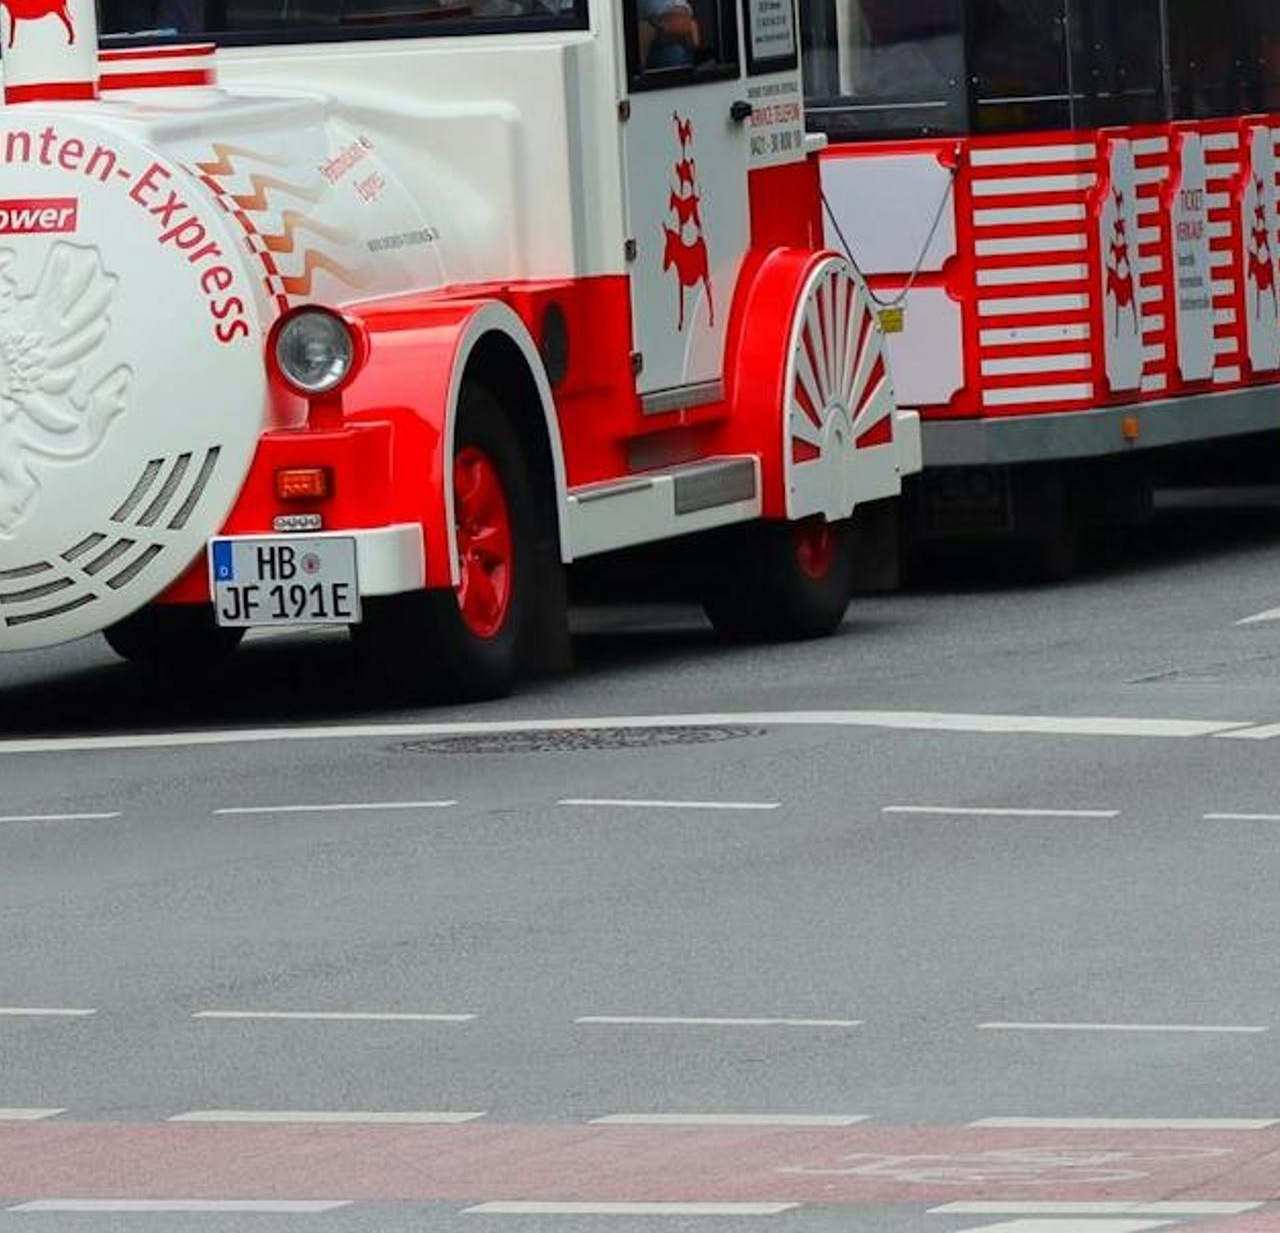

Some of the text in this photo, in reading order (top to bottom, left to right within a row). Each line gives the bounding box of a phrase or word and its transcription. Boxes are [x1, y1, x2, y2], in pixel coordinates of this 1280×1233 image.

[257, 546, 297, 580] HB
[222, 583, 351, 619] JF 191E
